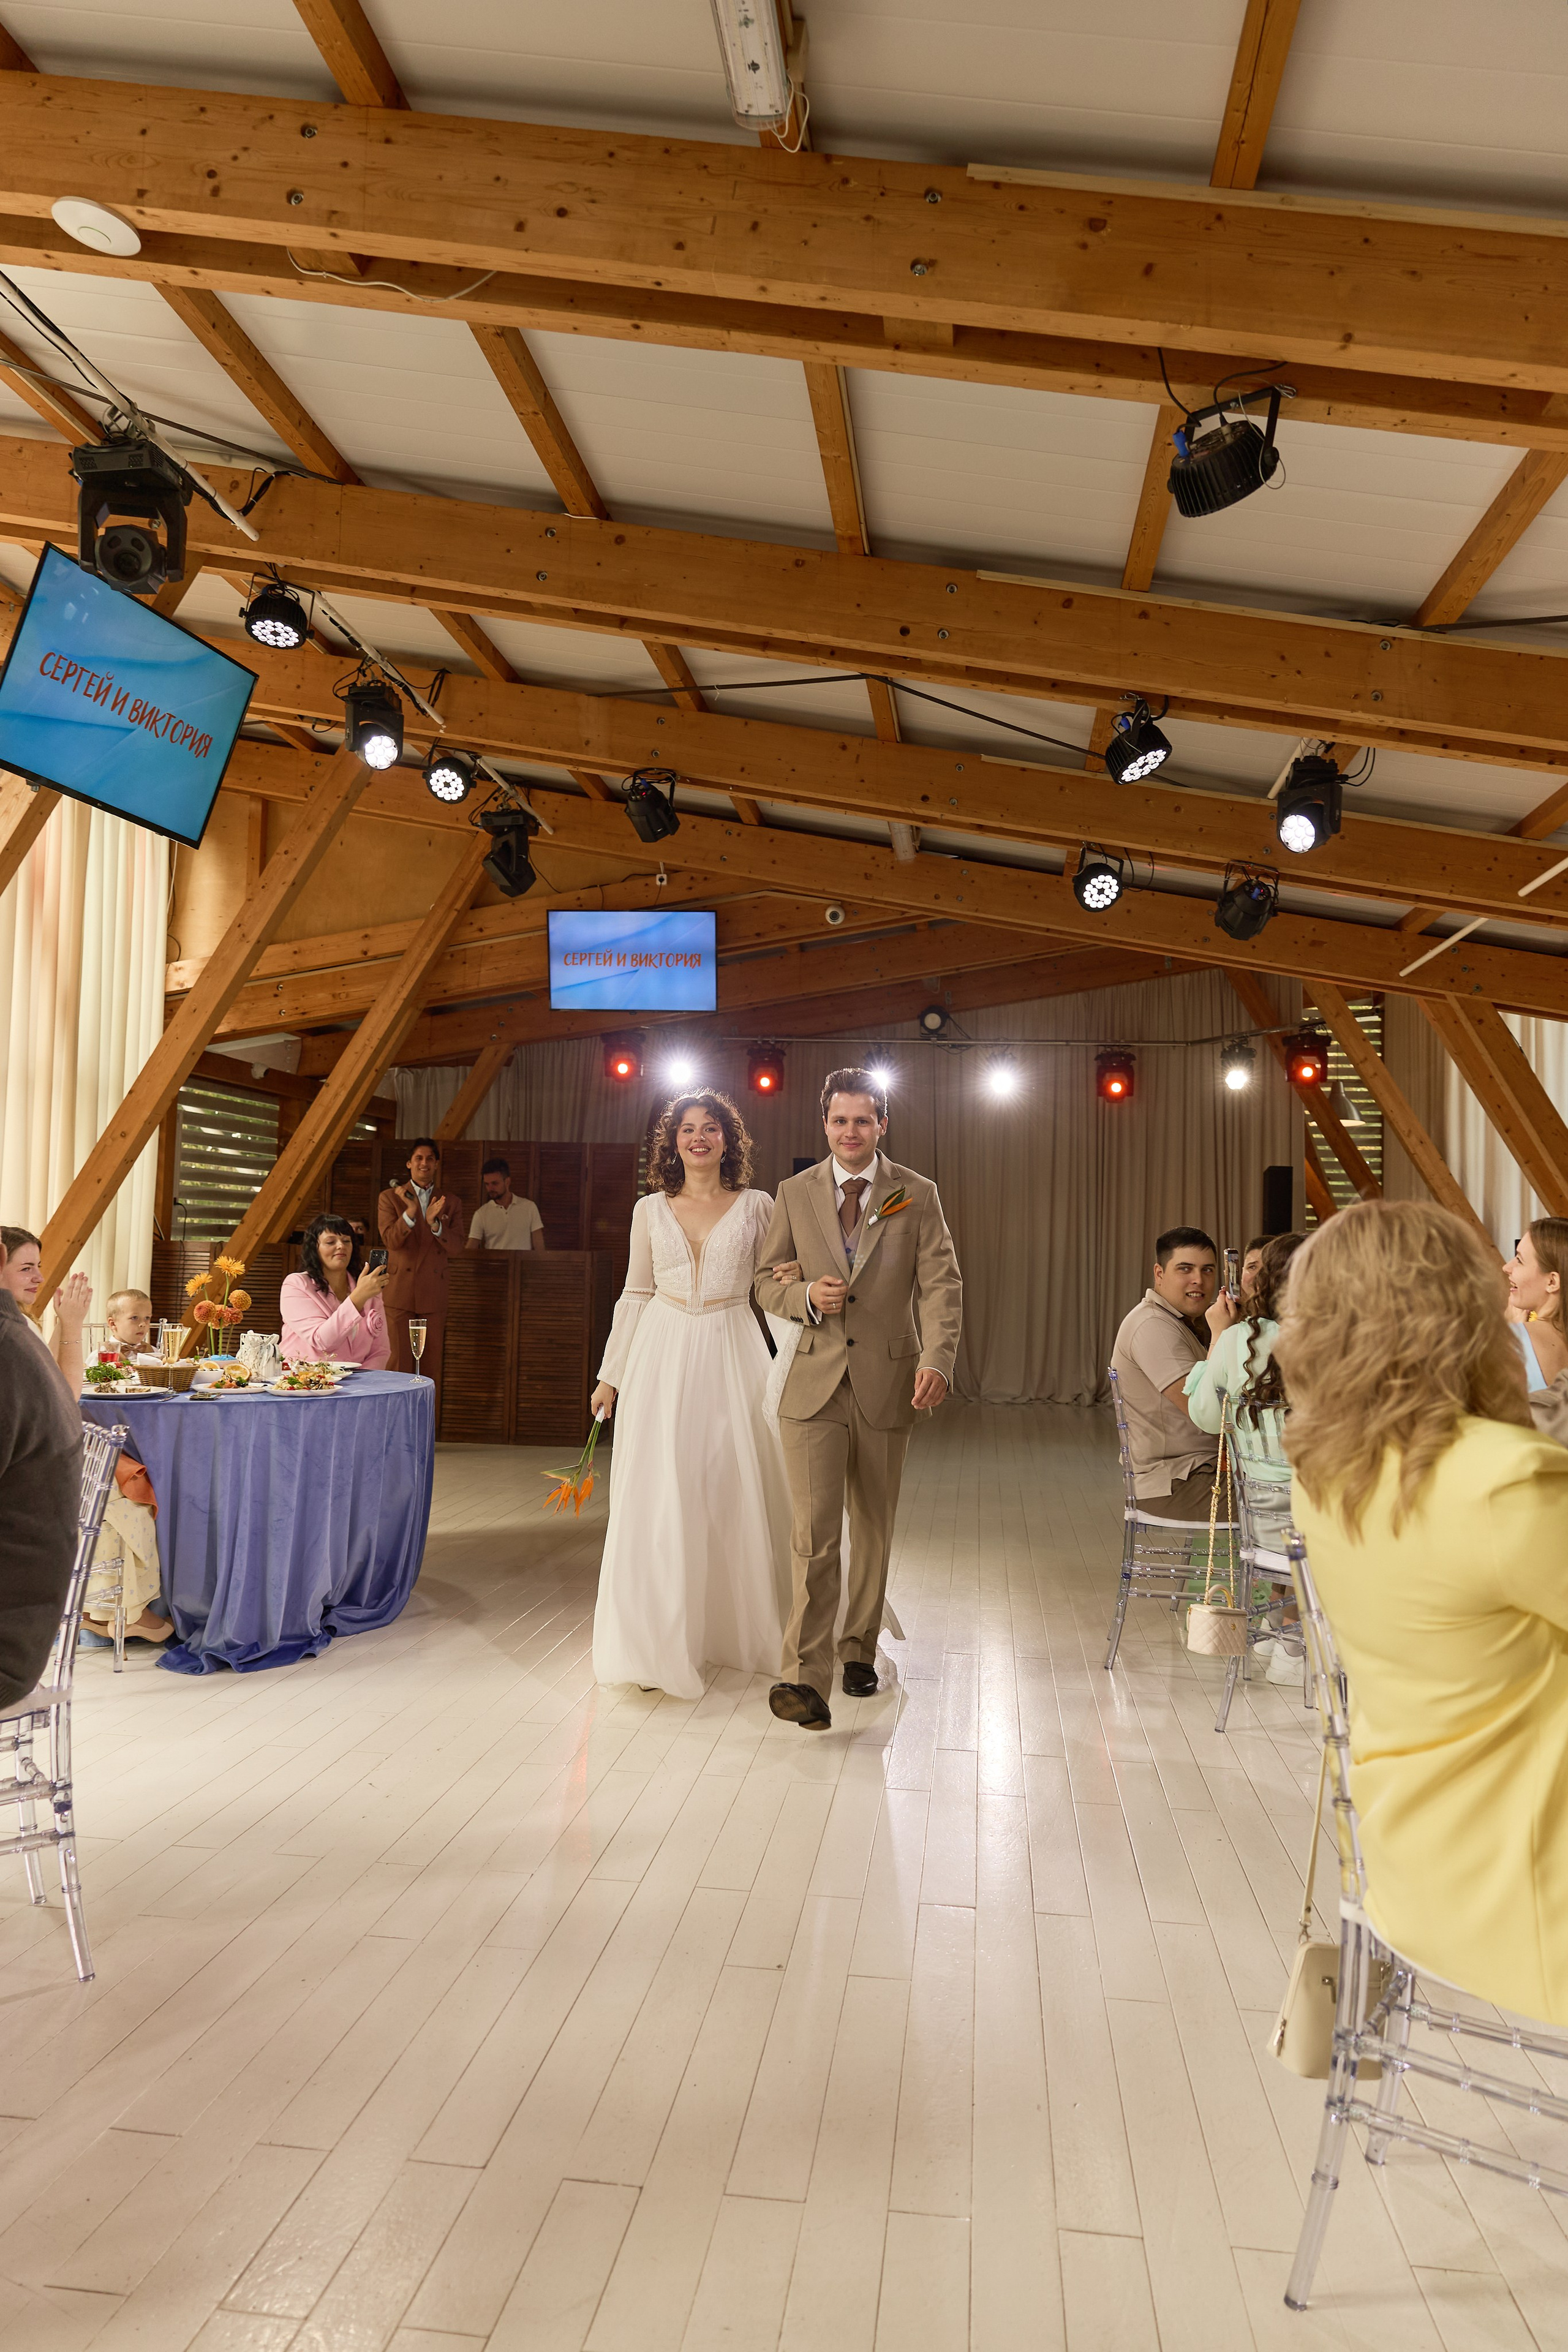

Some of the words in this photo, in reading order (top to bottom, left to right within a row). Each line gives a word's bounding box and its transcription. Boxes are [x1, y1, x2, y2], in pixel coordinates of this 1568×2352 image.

[39, 652, 115, 707] СЕРГЕЙ
[110, 687, 130, 716] И
[128, 698, 214, 758] ВИКТОРИЯ
[563, 949, 613, 967] СЕРГЕЙ
[616, 952, 627, 967] И
[630, 952, 701, 969] ВИКТОРИЯ
